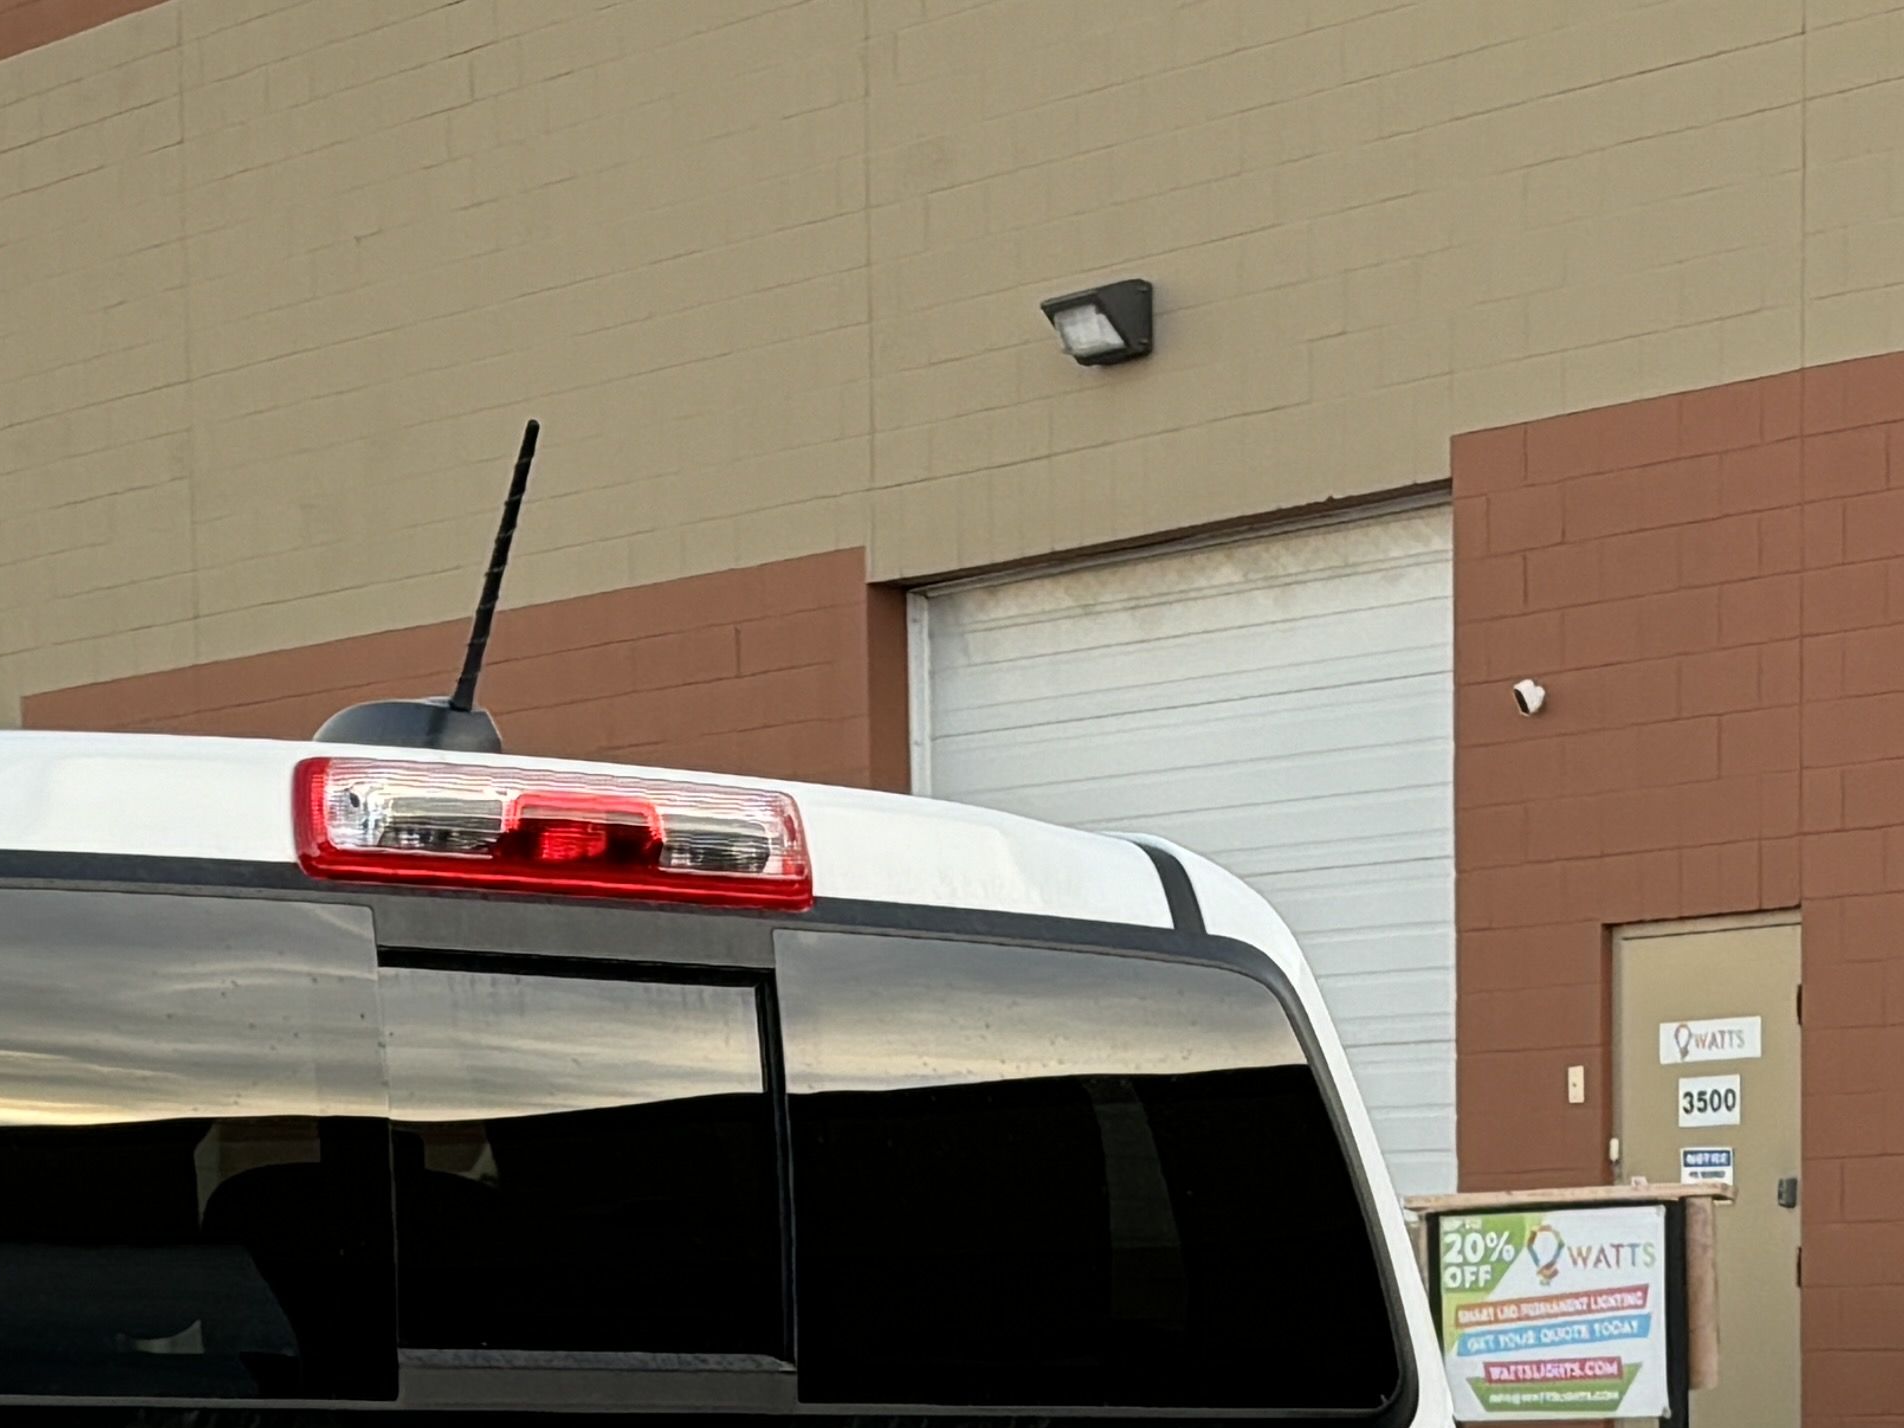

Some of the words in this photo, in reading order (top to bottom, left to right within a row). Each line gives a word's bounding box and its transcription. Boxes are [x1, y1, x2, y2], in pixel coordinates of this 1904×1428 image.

[1695, 1030, 1744, 1050] WATTS
[1683, 1088, 1736, 1114] 3500
[1443, 1230, 1515, 1264] 20%
[1568, 1243, 1656, 1268] WATTS
[1443, 1264, 1492, 1288] OFF
[1591, 1291, 1643, 1309] LIGHTING
[1467, 1335, 1495, 1350] GET
[1499, 1333, 1536, 1348] YOUR
[1540, 1324, 1590, 1343] QUOTE
[1594, 1320, 1639, 1337] TODAY
